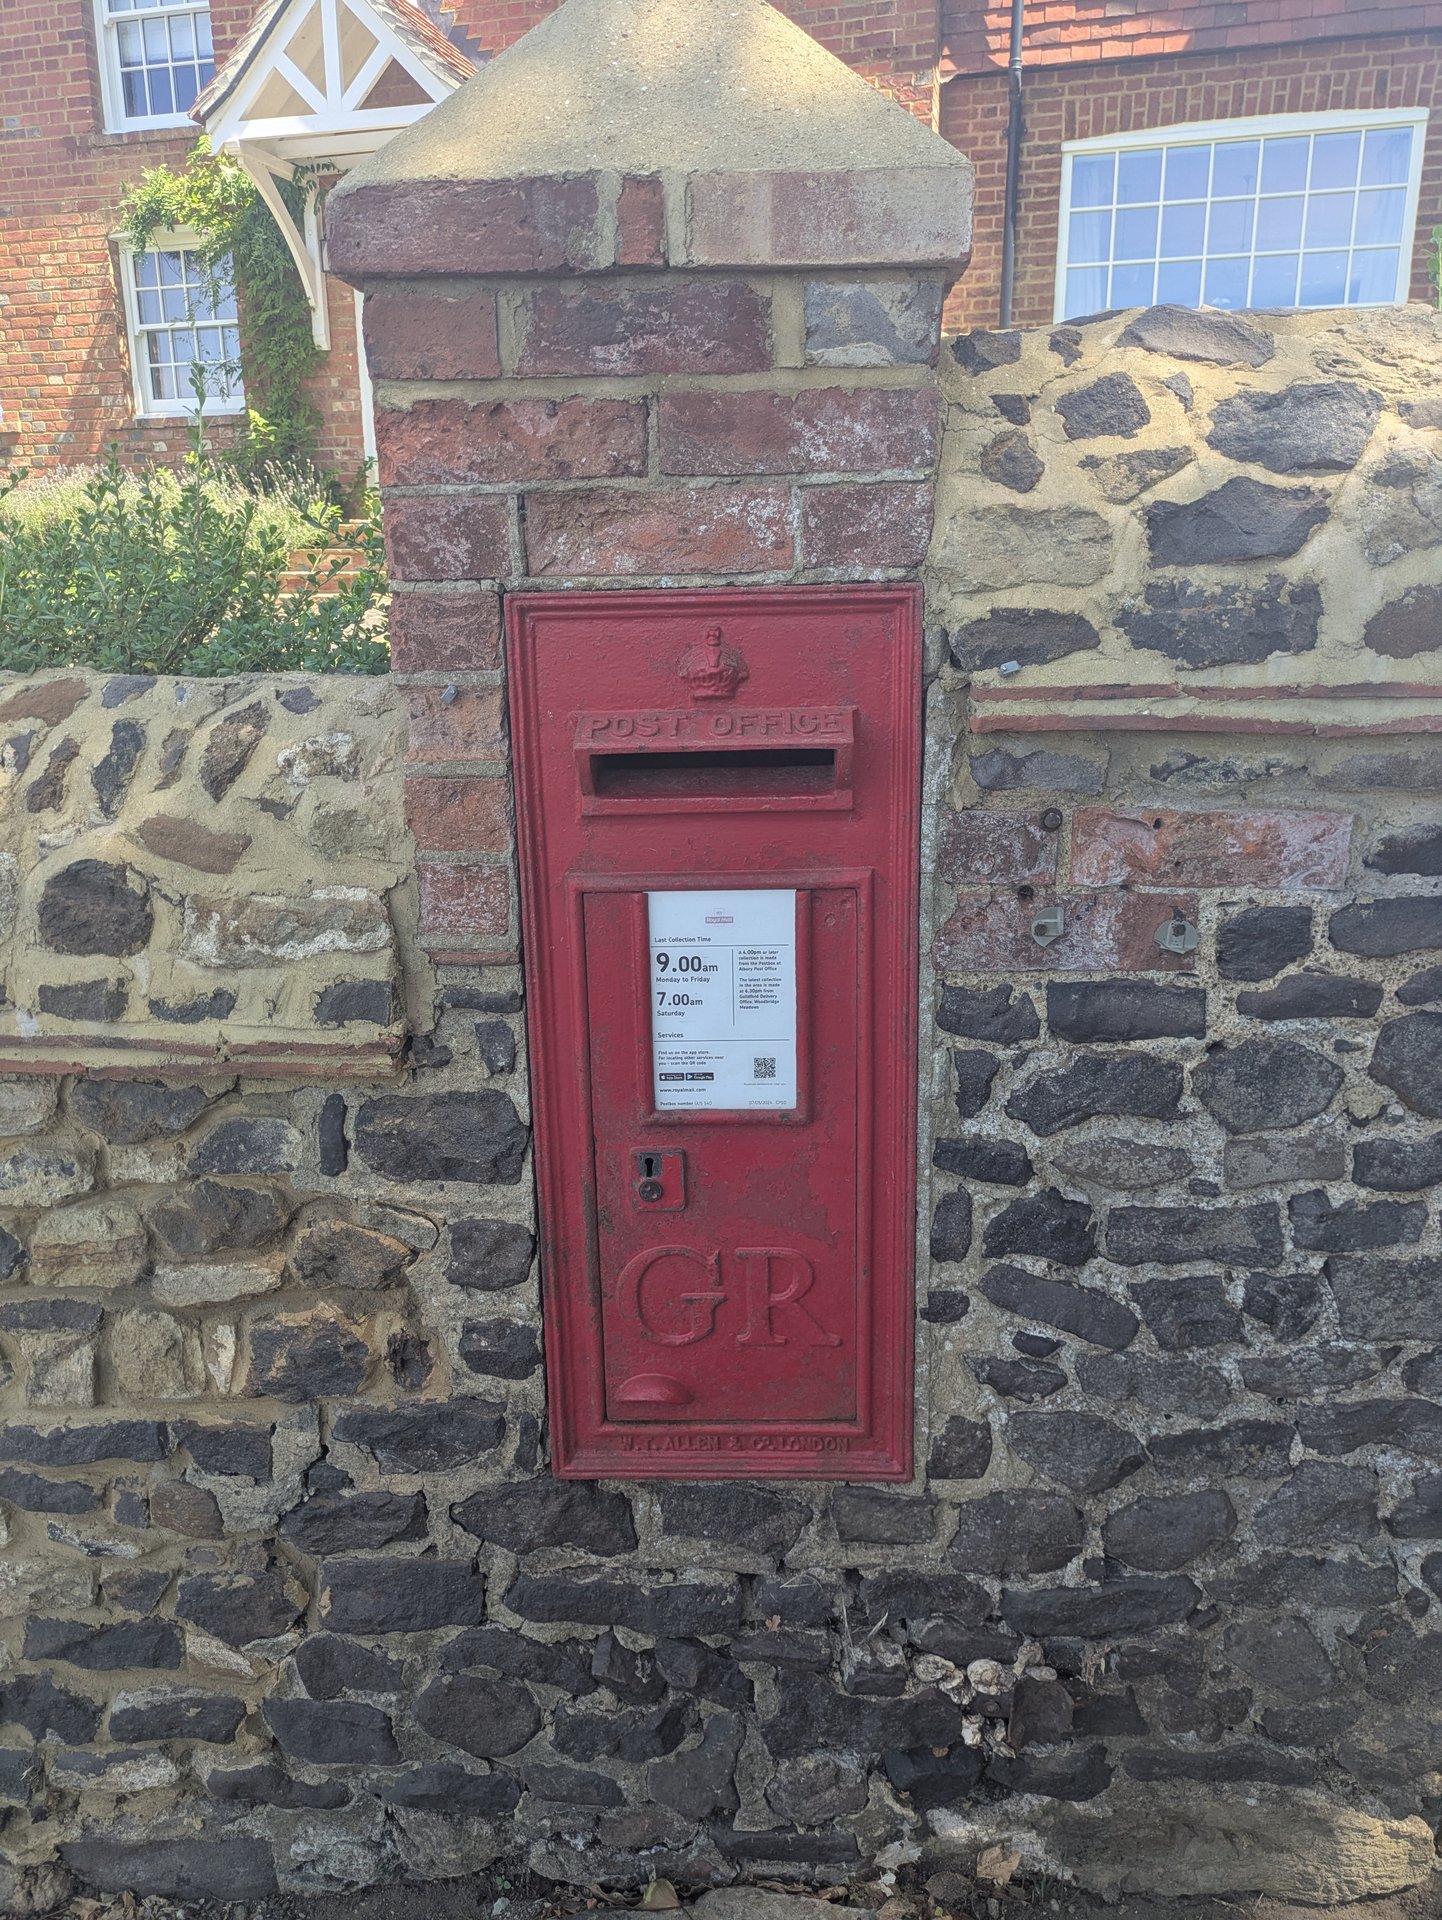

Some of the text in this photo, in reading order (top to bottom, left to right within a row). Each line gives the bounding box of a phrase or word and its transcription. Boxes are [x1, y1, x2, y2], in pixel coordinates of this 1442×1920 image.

[584, 711, 845, 739] POST OFFICE
[656, 952, 718, 973] 9.00am
[656, 991, 703, 1006] 7.00am
[617, 1244, 842, 1347] GR
[663, 1435, 721, 1451] ALLEN
[778, 1436, 851, 1451] LONDON
